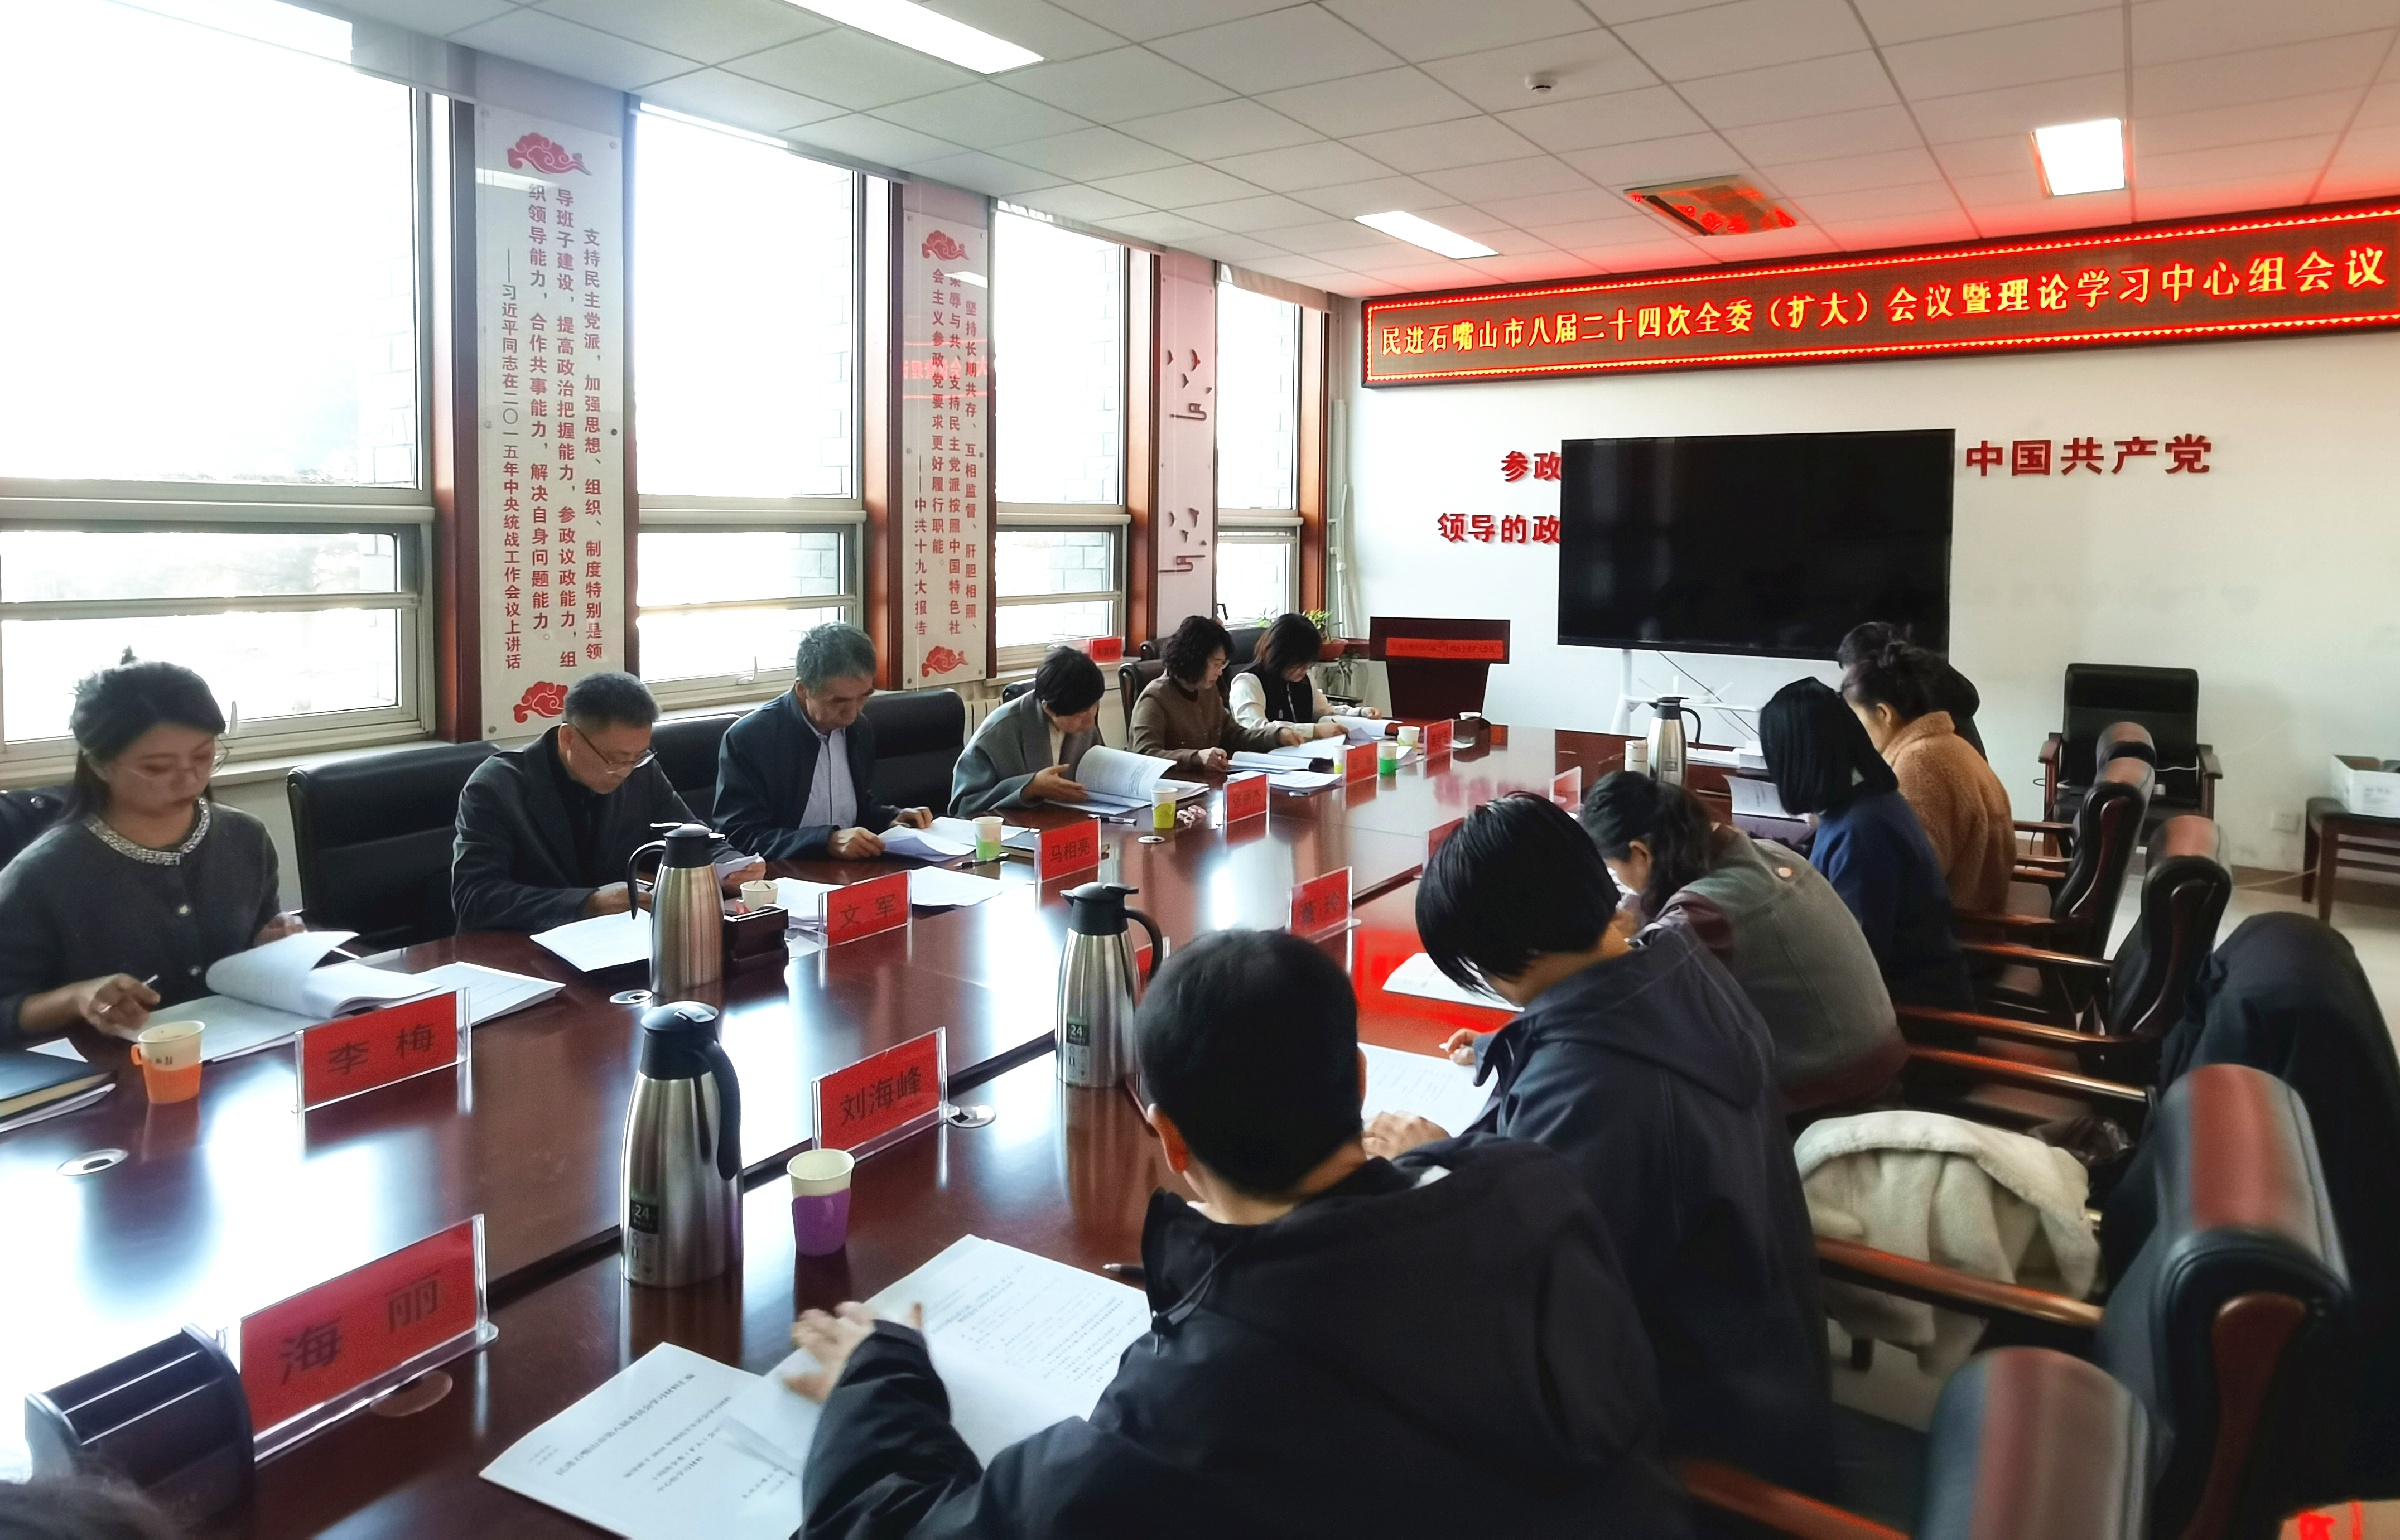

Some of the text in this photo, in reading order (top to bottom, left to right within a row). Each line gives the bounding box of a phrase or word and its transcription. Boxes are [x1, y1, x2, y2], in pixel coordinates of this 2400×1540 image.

[1380, 247, 2386, 358] 民进石嘴山市八届二十四次全委（扩大）会议暨理论学习中心组会议
[556, 188, 577, 669] 导班子建设，提高政治把握能力，参政议政能力，组
[584, 228, 603, 660] 支持民主党派，加强思想、组织、制度特别是领
[1965, 434, 2212, 477] 中国共产党
[1437, 512, 1561, 545] 领导的政
[840, 894, 896, 930] 文军
[328, 1023, 436, 1075] 李梅
[1070, 1024, 1083, 1037] 24
[840, 1065, 922, 1127] 刘海峰
[634, 1204, 650, 1219] 24
[280, 1267, 442, 1386] 海丽
